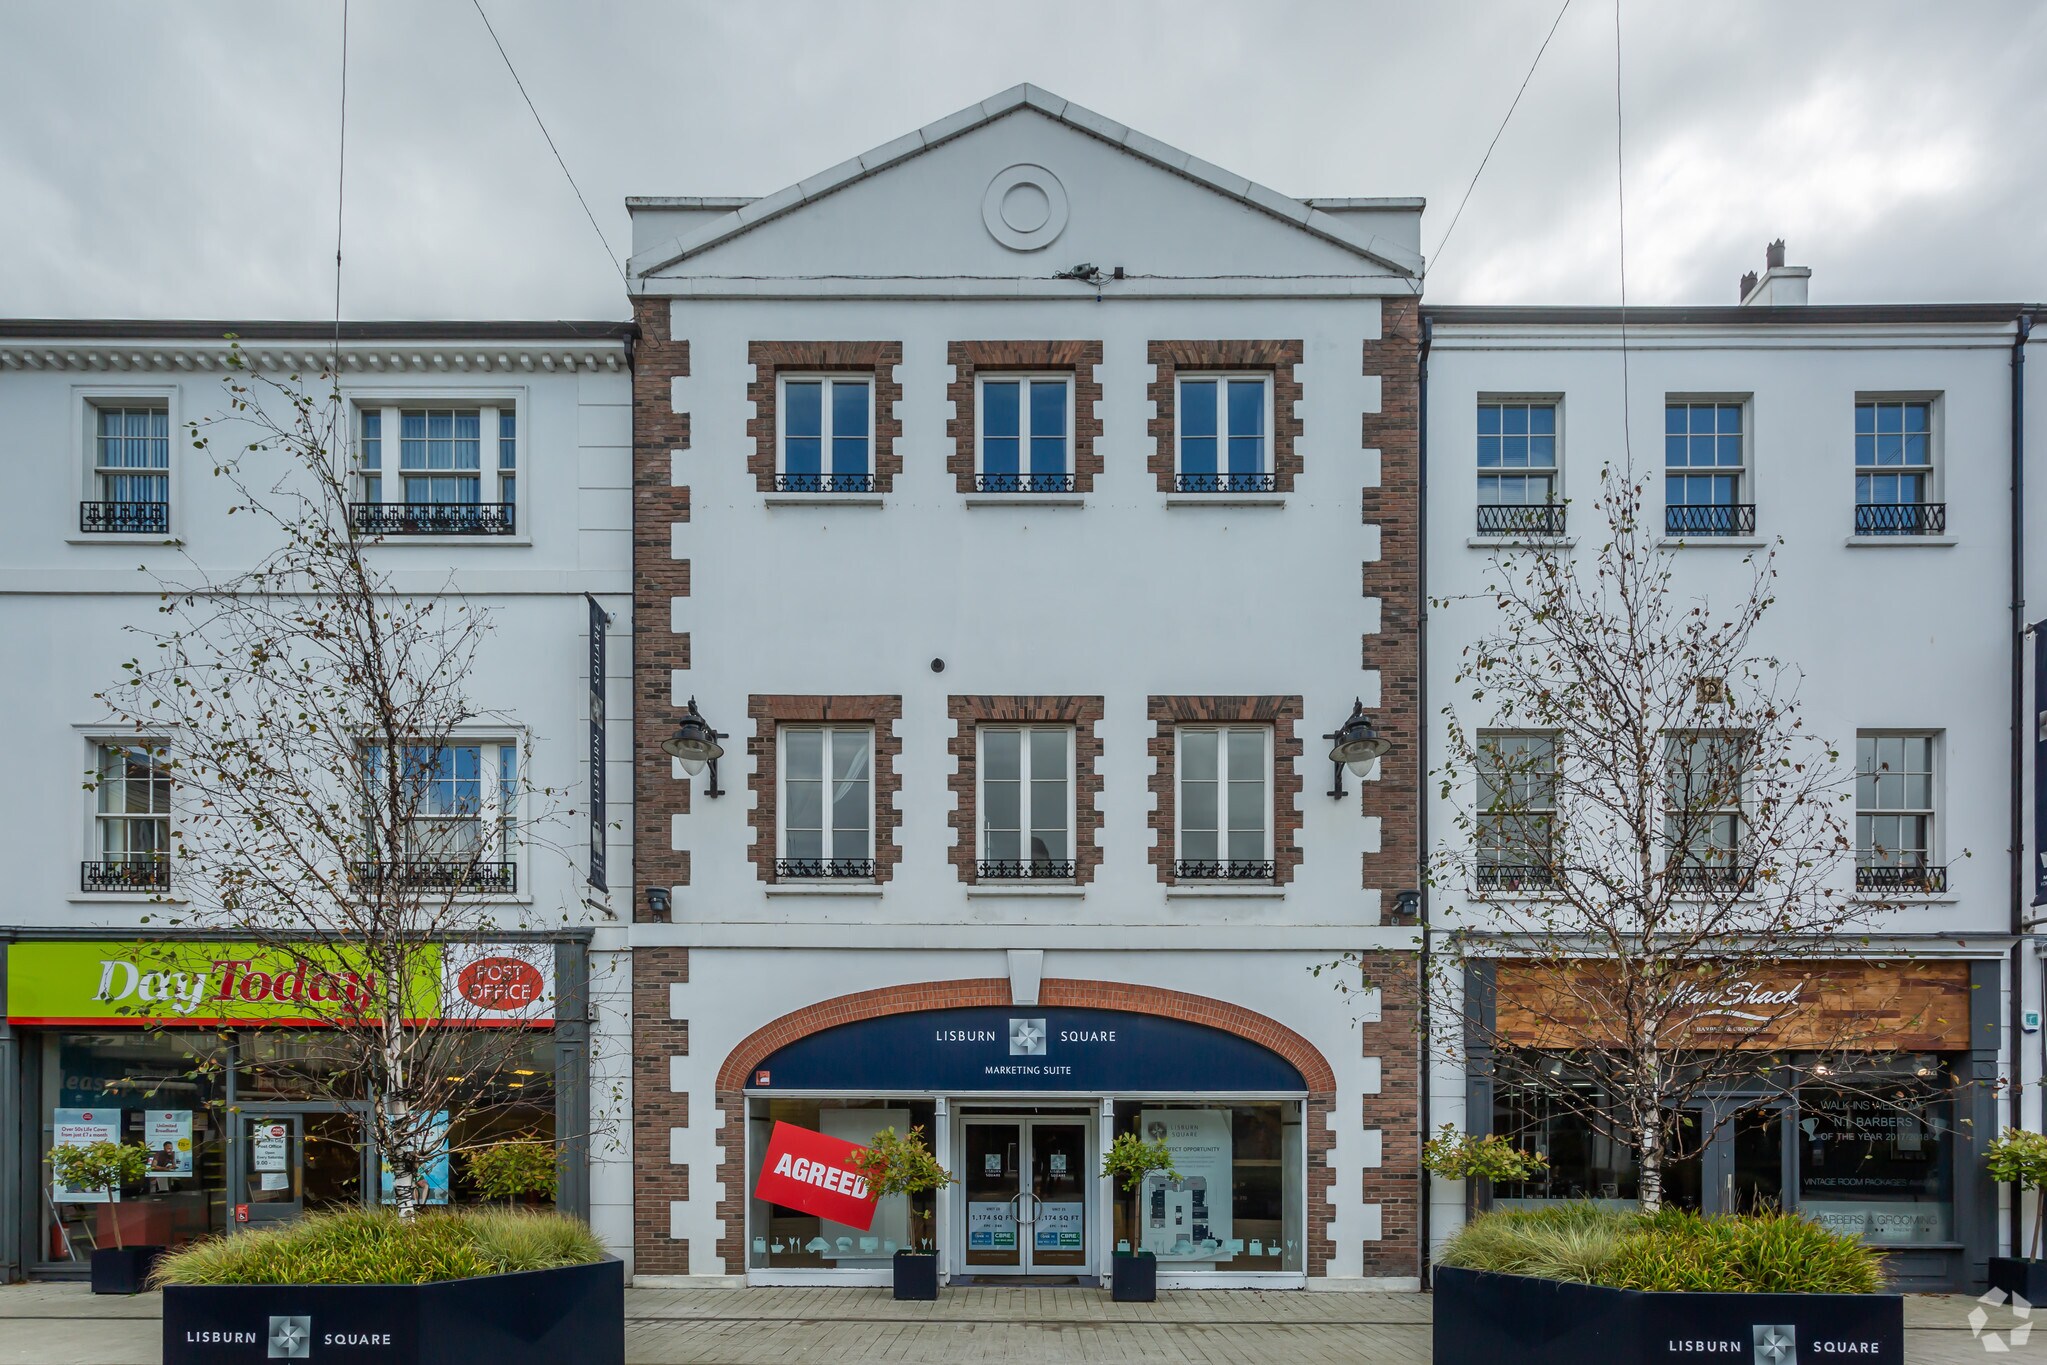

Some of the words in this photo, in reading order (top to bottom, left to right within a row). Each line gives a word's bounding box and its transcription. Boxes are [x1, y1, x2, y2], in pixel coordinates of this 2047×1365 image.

[476, 965, 524, 981] POST
[469, 984, 531, 1000] OFFICE
[1718, 981, 1803, 1006] Shack
[936, 1030, 996, 1042] LISBURN
[1060, 1030, 1116, 1042] SQUARE
[985, 1066, 1041, 1075] MARKETING
[1043, 1066, 1072, 1075] SUITE
[1820, 1100, 1870, 1110] WALK-INS
[1856, 1117, 1913, 1127] BARBERS
[1820, 1132, 1834, 1141] OF
[1836, 1132, 1855, 1141] THE
[1857, 1132, 1883, 1141] YEAR
[774, 1152, 871, 1200] AGREED
[1803, 1177, 1836, 1186] VINTAGE
[1837, 1177, 1865, 1186] ROOM
[1864, 1177, 1907, 1186] PACKAGES
[1867, 1214, 1875, 1224] &
[1877, 1214, 1938, 1225] GROOMING
[187, 1331, 256, 1344] LISBURN
[324, 1333, 391, 1346] SQUARE
[1669, 1340, 1741, 1352] LISBURN
[1813, 1341, 1879, 1354] SQUARE
